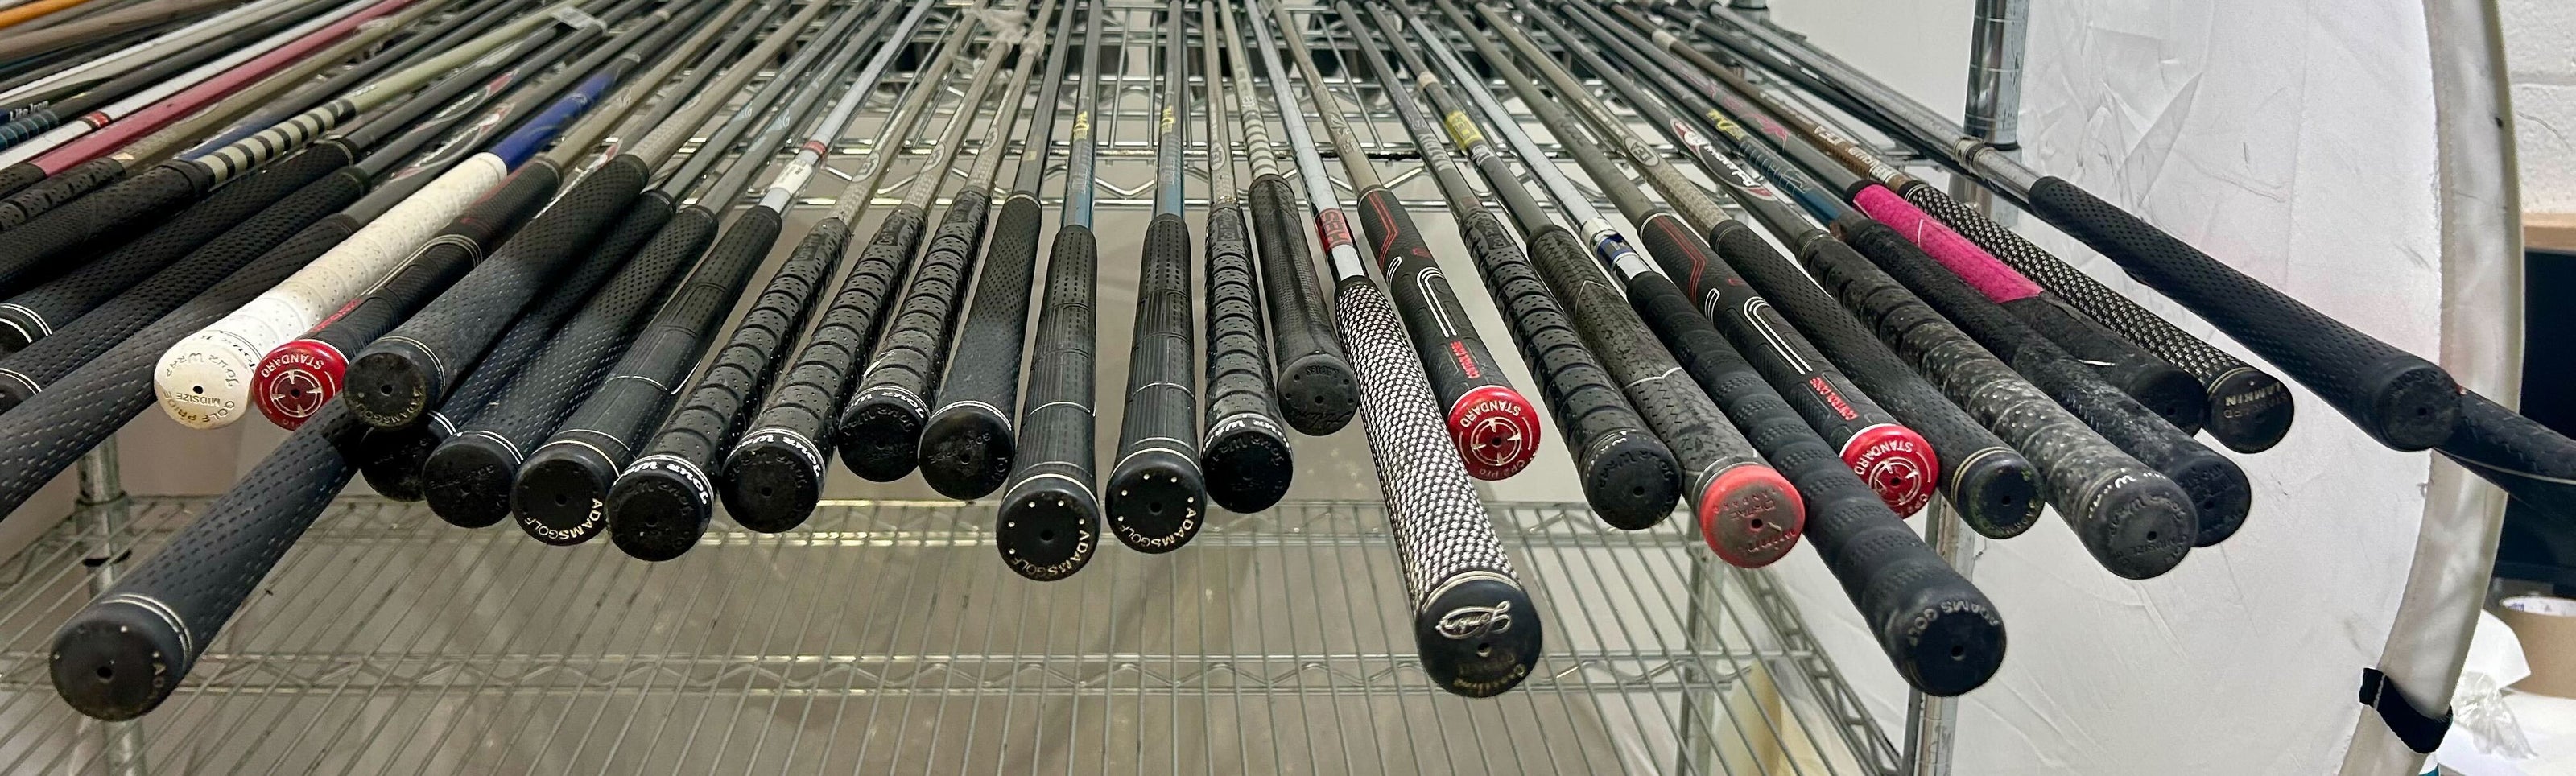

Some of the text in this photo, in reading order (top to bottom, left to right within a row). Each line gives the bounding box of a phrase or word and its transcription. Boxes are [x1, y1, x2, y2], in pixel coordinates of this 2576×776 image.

[10, 100, 49, 122] Lite Iron
[1629, 142, 1655, 163] IDEA
[261, 353, 325, 378] STANDARD
[163, 390, 235, 423] GOLF PRIDE
[175, 392, 221, 407] MIDSIZE
[1809, 377, 1860, 421] CONTROL CORE
[2224, 382, 2281, 407] LAMKIN
[1459, 400, 1521, 428] STANDARD
[1853, 440, 1914, 476] STANDARD
[523, 497, 604, 541] ADAMSGOLF
[1117, 506, 1198, 548] ADAMSGOLF
[1013, 529, 1092, 576] ADAMSGOLF
[1435, 600, 1512, 641] Lamkin
